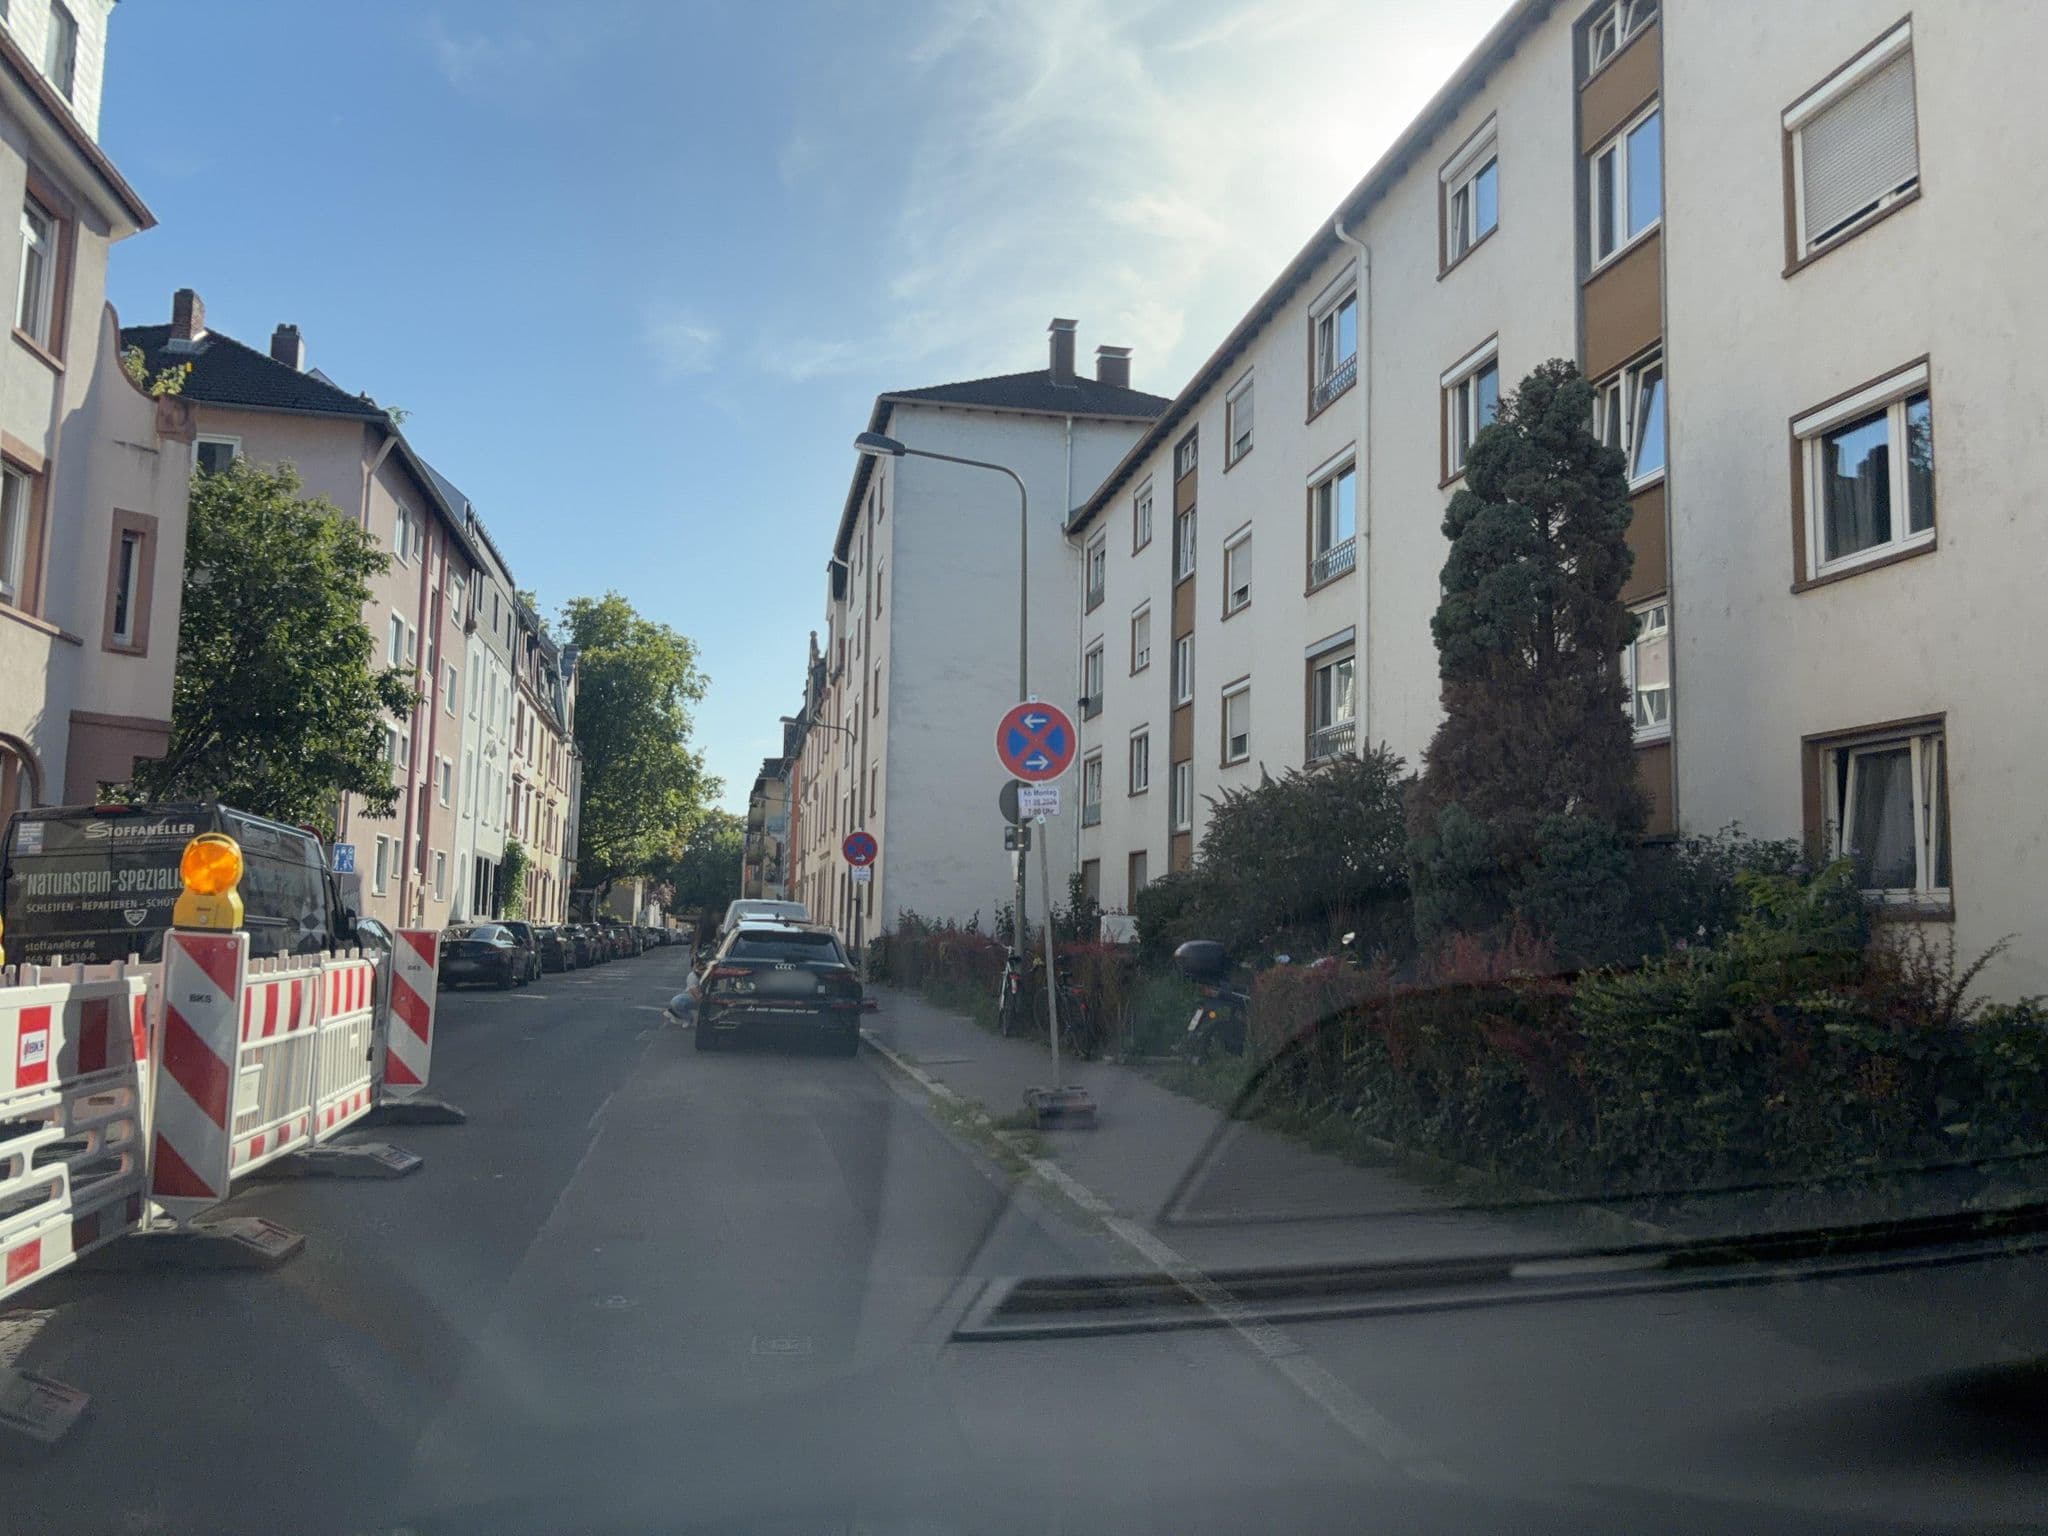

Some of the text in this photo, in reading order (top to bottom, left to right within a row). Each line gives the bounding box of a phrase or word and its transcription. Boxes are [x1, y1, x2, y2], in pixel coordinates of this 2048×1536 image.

[1033, 789, 1057, 797] Montag
[1042, 807, 1055, 815] Uhr
[83, 819, 196, 839] STOFFANELLER
[26, 902, 74, 913] SCHLEIFEN
[81, 899, 137, 911] REPARIEREN
[24, 938, 96, 952] stoffaneller.de
